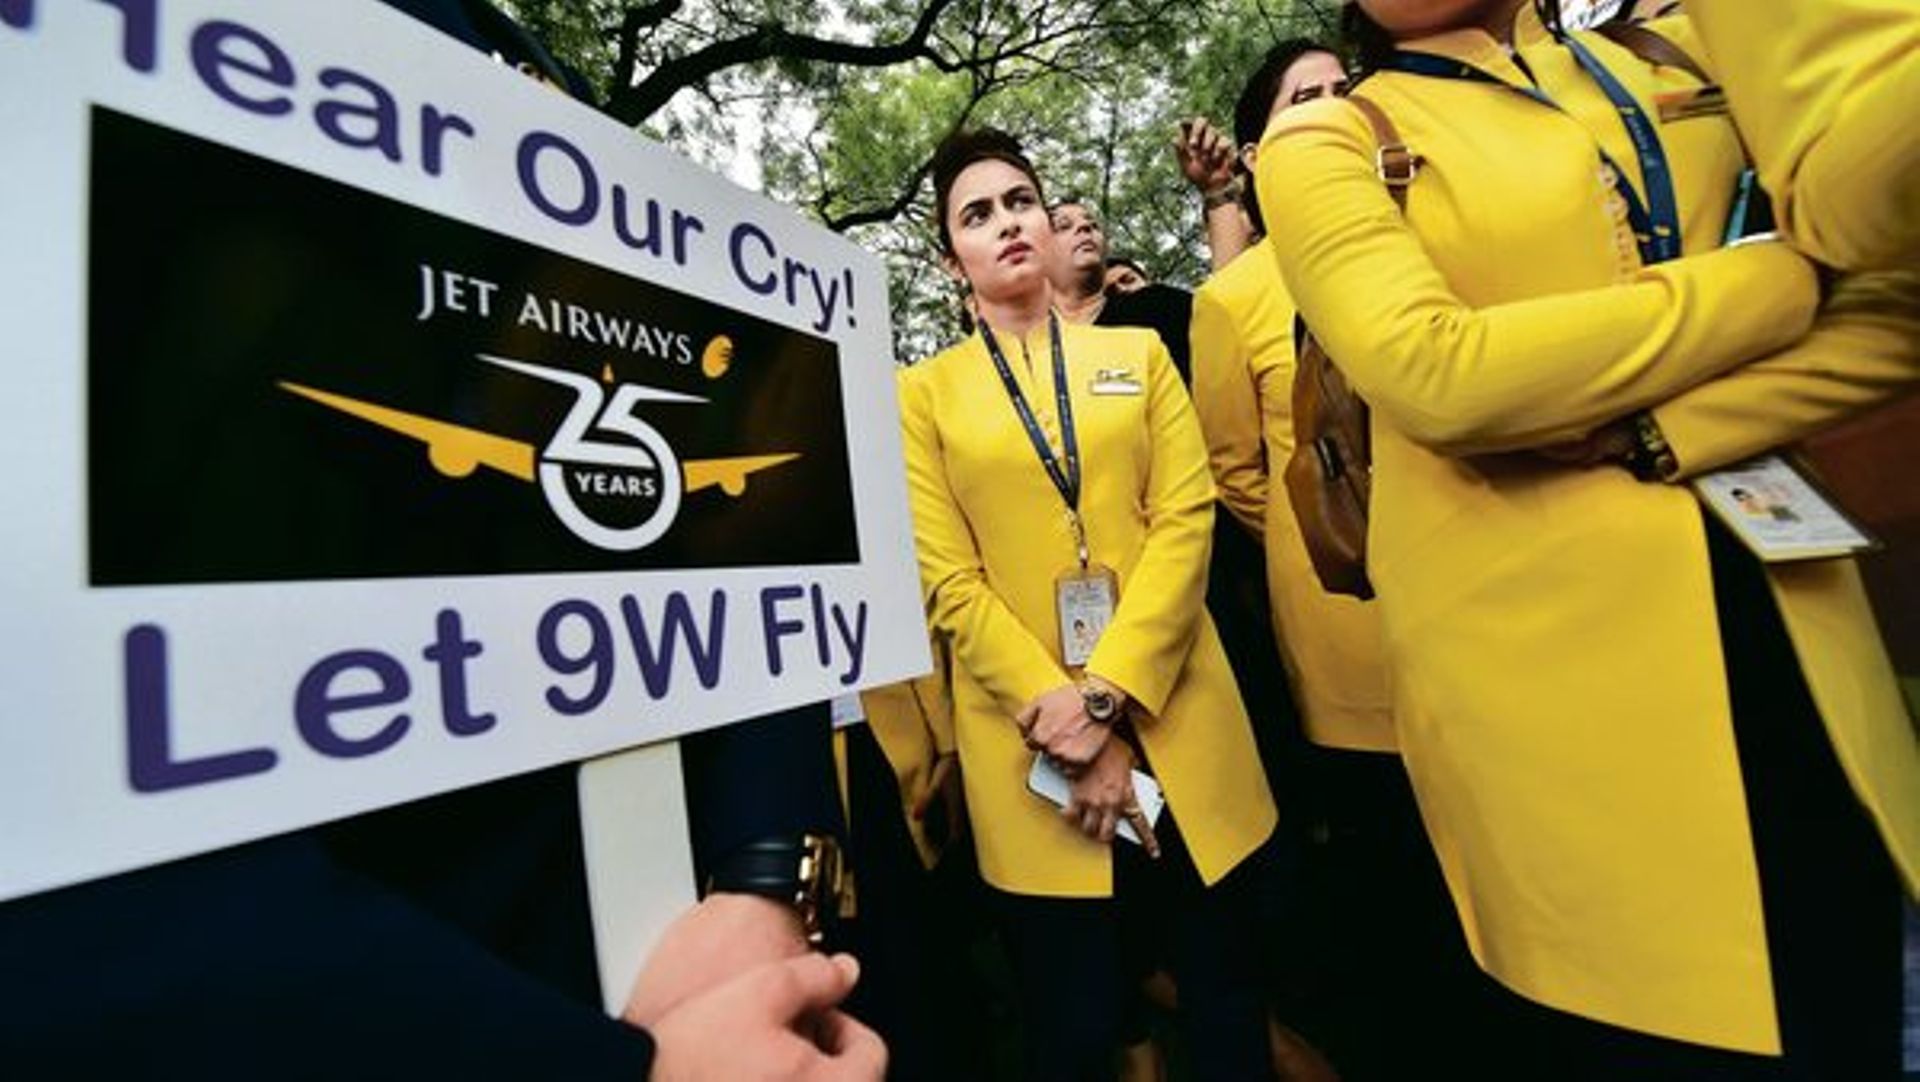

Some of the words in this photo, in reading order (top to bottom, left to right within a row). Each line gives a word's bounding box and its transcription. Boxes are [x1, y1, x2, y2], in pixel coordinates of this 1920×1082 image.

[417, 264, 498, 320] JET
[517, 293, 695, 366] AIRWAYS
[515, 130, 704, 267] Our
[728, 221, 859, 333] Cry!
[475, 352, 712, 551] 25
[574, 471, 657, 497] YEARS
[123, 607, 498, 795] Let
[535, 588, 727, 717] 9W
[760, 583, 868, 686] Fly
